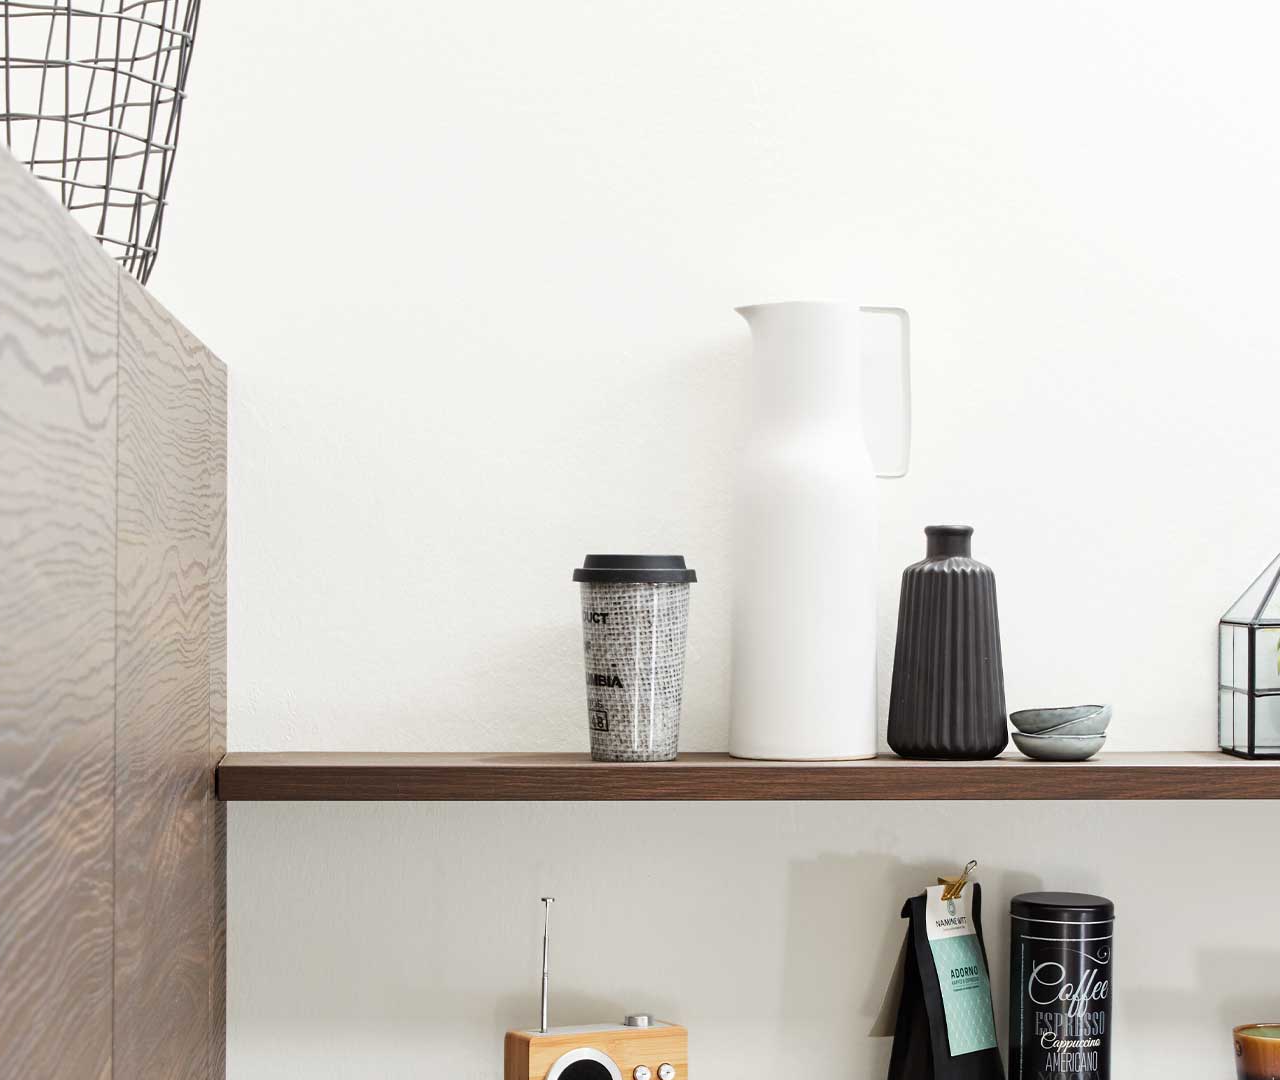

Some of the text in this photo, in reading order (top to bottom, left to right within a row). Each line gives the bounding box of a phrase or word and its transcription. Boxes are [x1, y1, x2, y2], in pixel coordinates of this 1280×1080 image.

[951, 965, 979, 979] ADORNO
[1028, 960, 1109, 1018] Coffee
[1034, 1011, 1105, 1037] ESPRESSO
[1040, 1031, 1101, 1053] Cappuccino
[1045, 1051, 1098, 1073] AMERICANO
